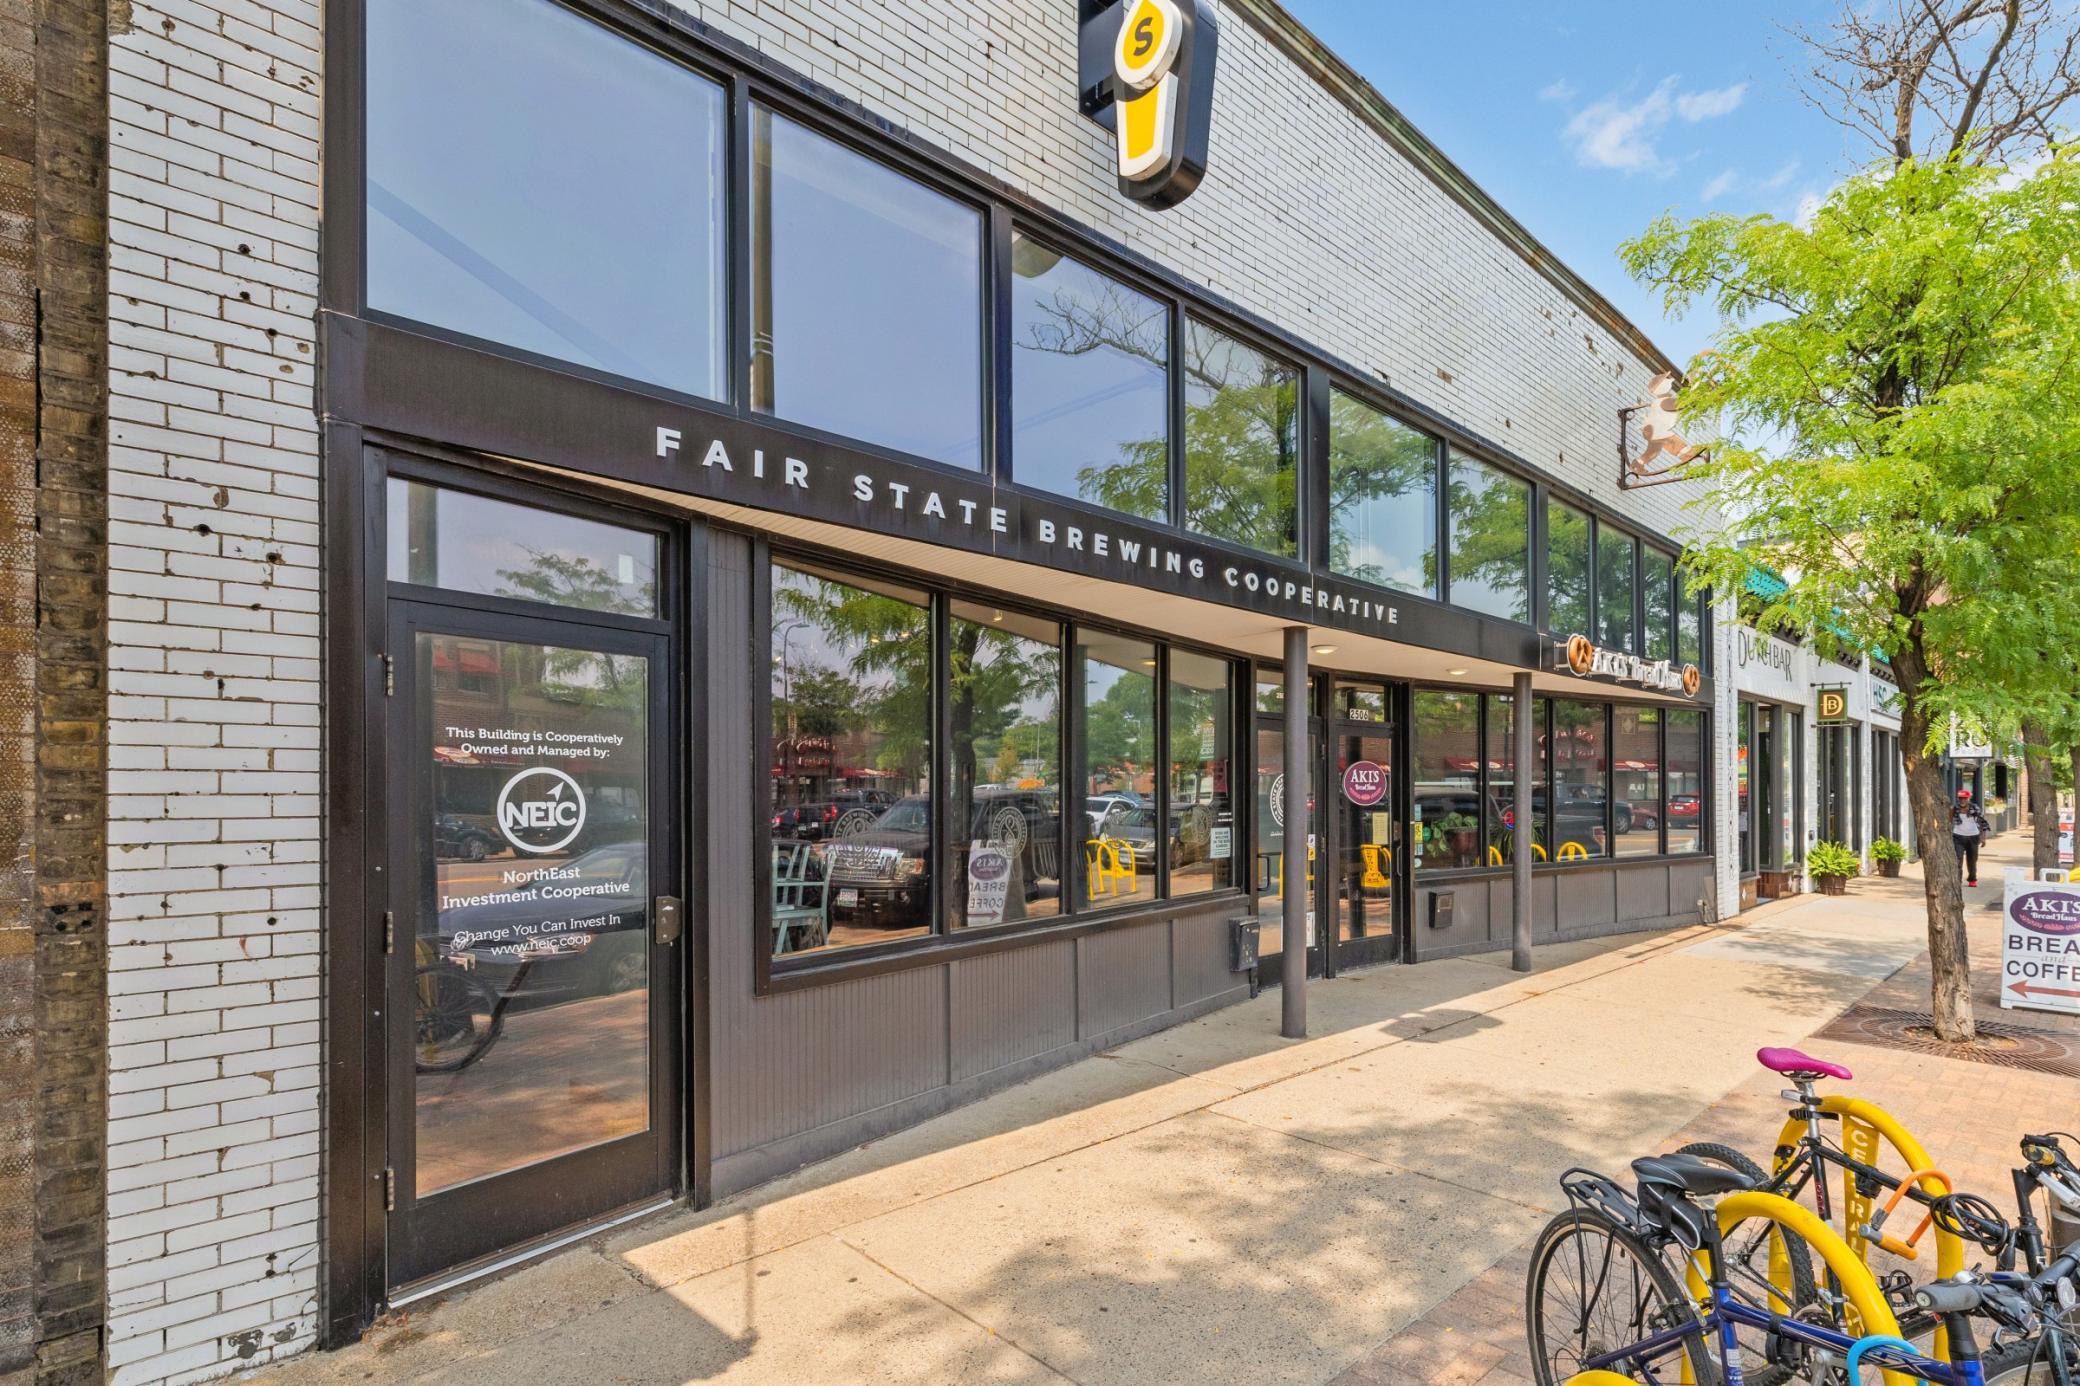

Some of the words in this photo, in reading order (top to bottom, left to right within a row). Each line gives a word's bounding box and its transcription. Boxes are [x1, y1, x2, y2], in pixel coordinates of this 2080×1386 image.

[1133, 16, 1154, 57] S
[656, 426, 809, 489] FAIR
[853, 474, 1008, 533] STATE
[1038, 519, 1204, 579] BREWING
[1224, 567, 1399, 625] COOPERATIVE
[1350, 709, 1368, 720] 2506
[445, 727, 475, 739] This
[478, 728, 530, 743] Building
[533, 730, 543, 741] is
[545, 731, 623, 746] Cooperatively
[461, 743, 508, 755] Owned
[511, 744, 535, 755] and
[537, 745, 591, 758] Managed
[594, 747, 610, 758] by:
[505, 801, 577, 828] NEIC
[502, 867, 581, 884] NorthEast
[442, 888, 537, 909] Investment
[541, 882, 630, 902] Cooperative
[454, 925, 509, 943] Change
[512, 922, 538, 936] You
[541, 920, 567, 933] Can
[570, 917, 606, 930] Invest
[609, 915, 621, 926] In
[490, 933, 592, 956] www.neic.coop
[1849, 1129, 1869, 1255] CERAL
